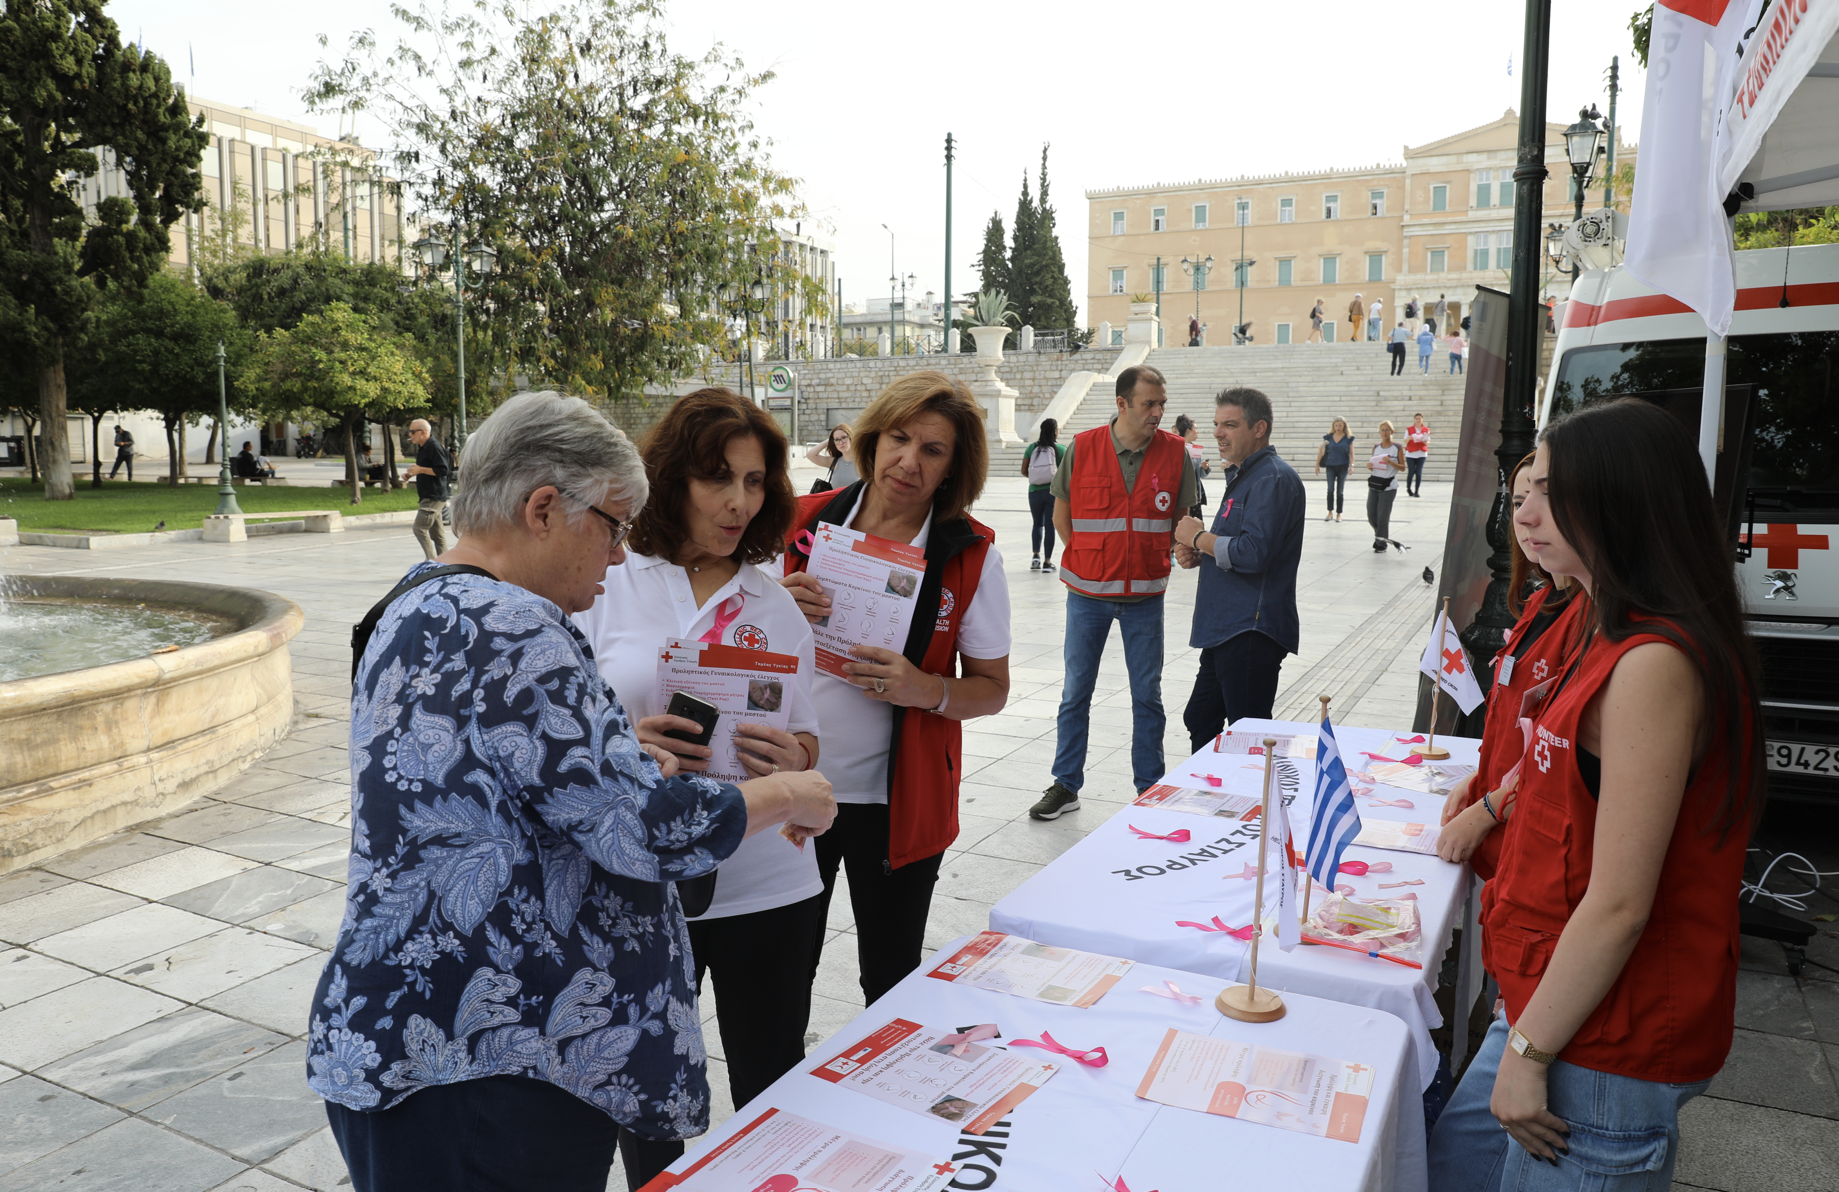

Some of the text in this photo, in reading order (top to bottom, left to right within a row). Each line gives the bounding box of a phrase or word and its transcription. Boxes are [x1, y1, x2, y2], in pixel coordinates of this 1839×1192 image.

[750, 626, 761, 634] RED
[671, 667, 780, 681] Προληπτικός Γυναικολογικός έλεγχος
[701, 770, 738, 782] Πρόληψη
[1111, 838, 1246, 881] ΣΤΑΥΡΟΣ
[918, 1036, 935, 1045] Βάλε
[880, 1052, 910, 1070] Πρόληψη
[859, 1076, 874, 1084] την
[820, 1135, 841, 1149] Μέτρα
